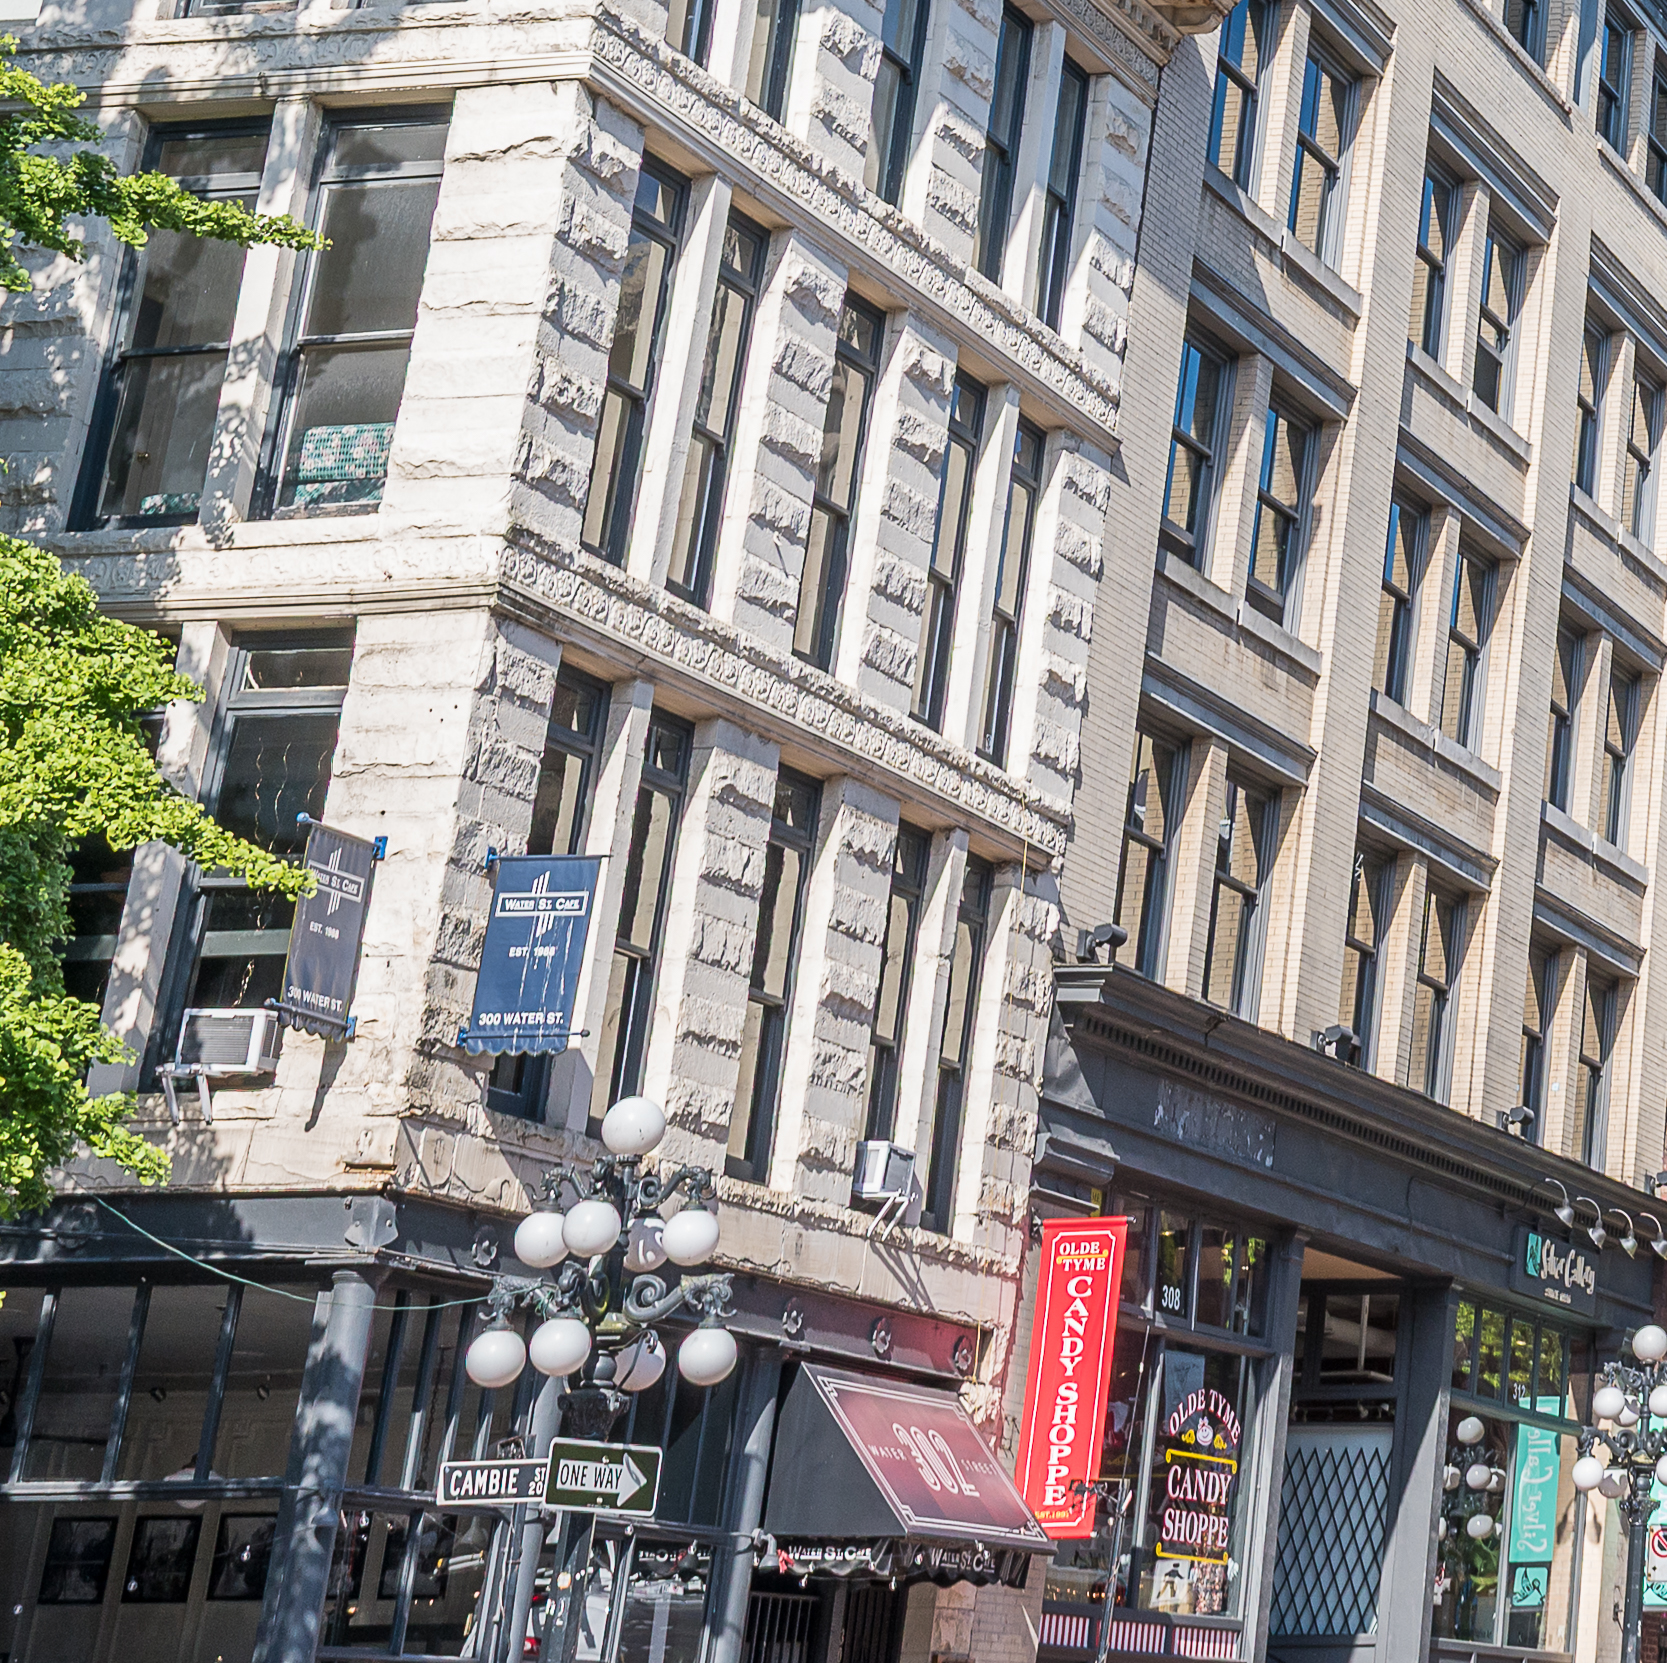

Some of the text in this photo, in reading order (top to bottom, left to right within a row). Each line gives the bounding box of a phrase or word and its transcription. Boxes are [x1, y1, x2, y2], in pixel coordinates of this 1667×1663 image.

[287, 986, 301, 1000] 300
[303, 990, 331, 1009] WATER
[478, 1012, 564, 1026] 300 WATER ST.
[1059, 1241, 1100, 1255] OLDE
[1062, 1257, 1106, 1272] TYME
[1161, 1285, 1181, 1311] 308
[1059, 1275, 1093, 1377] CANDY
[1512, 1383, 1526, 1400] 312
[1169, 1388, 1242, 1446] OLDE TYME
[1042, 1382, 1079, 1506] SHOPPE
[868, 1444, 907, 1462] WATER
[960, 1458, 999, 1476] STREET
[449, 1468, 520, 1497] CAMBIE
[534, 1467, 547, 1483] ST
[560, 1464, 624, 1490] ONE WAY
[1166, 1464, 1232, 1507] CANDY
[1162, 1507, 1229, 1549] SHOPPE
[789, 1545, 823, 1560] WATER
